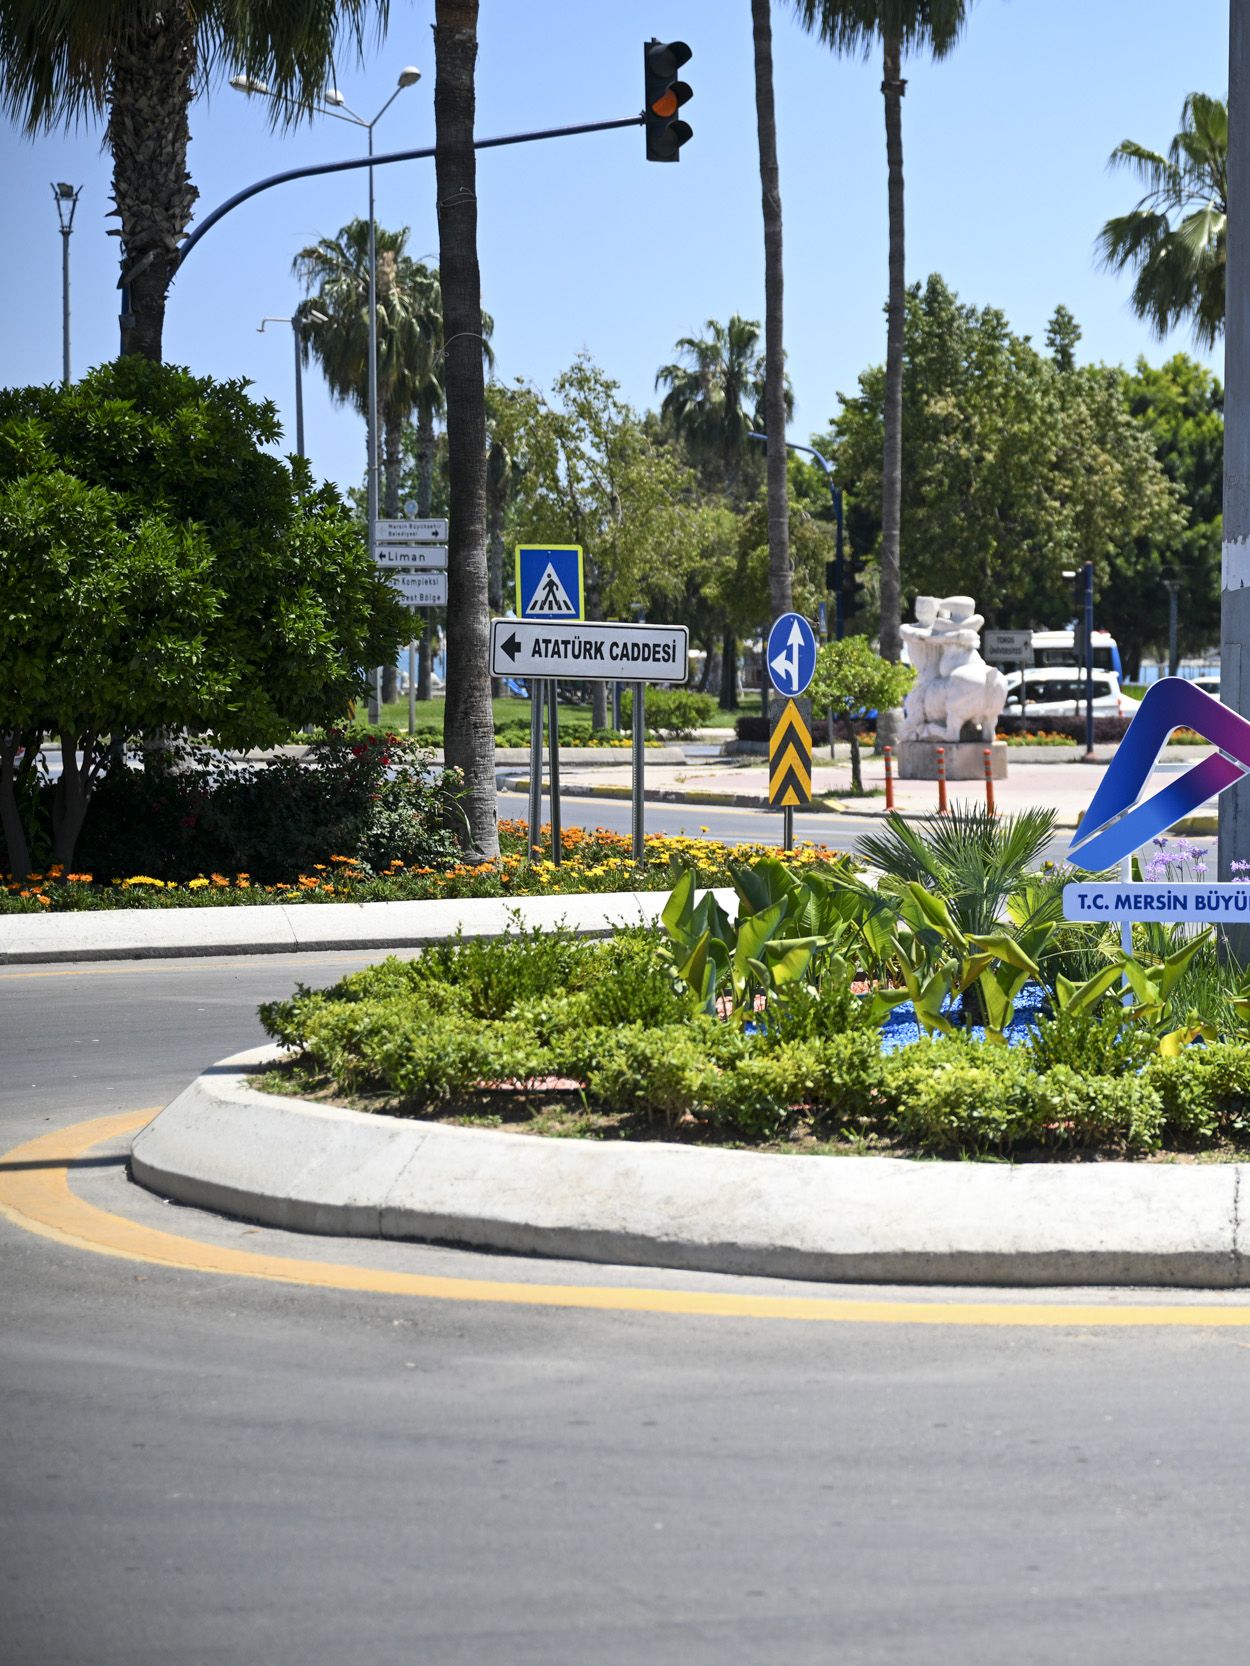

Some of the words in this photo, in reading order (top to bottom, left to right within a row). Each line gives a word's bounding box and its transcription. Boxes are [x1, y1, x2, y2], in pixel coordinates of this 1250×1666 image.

[388, 552, 425, 561] Liman
[402, 577, 439, 587] Kompleksi
[531, 636, 605, 660] ATATÜRK
[609, 640, 676, 663] CADDESİ
[1078, 894, 1109, 910] T.C.
[1115, 890, 1188, 911] MERSİN
